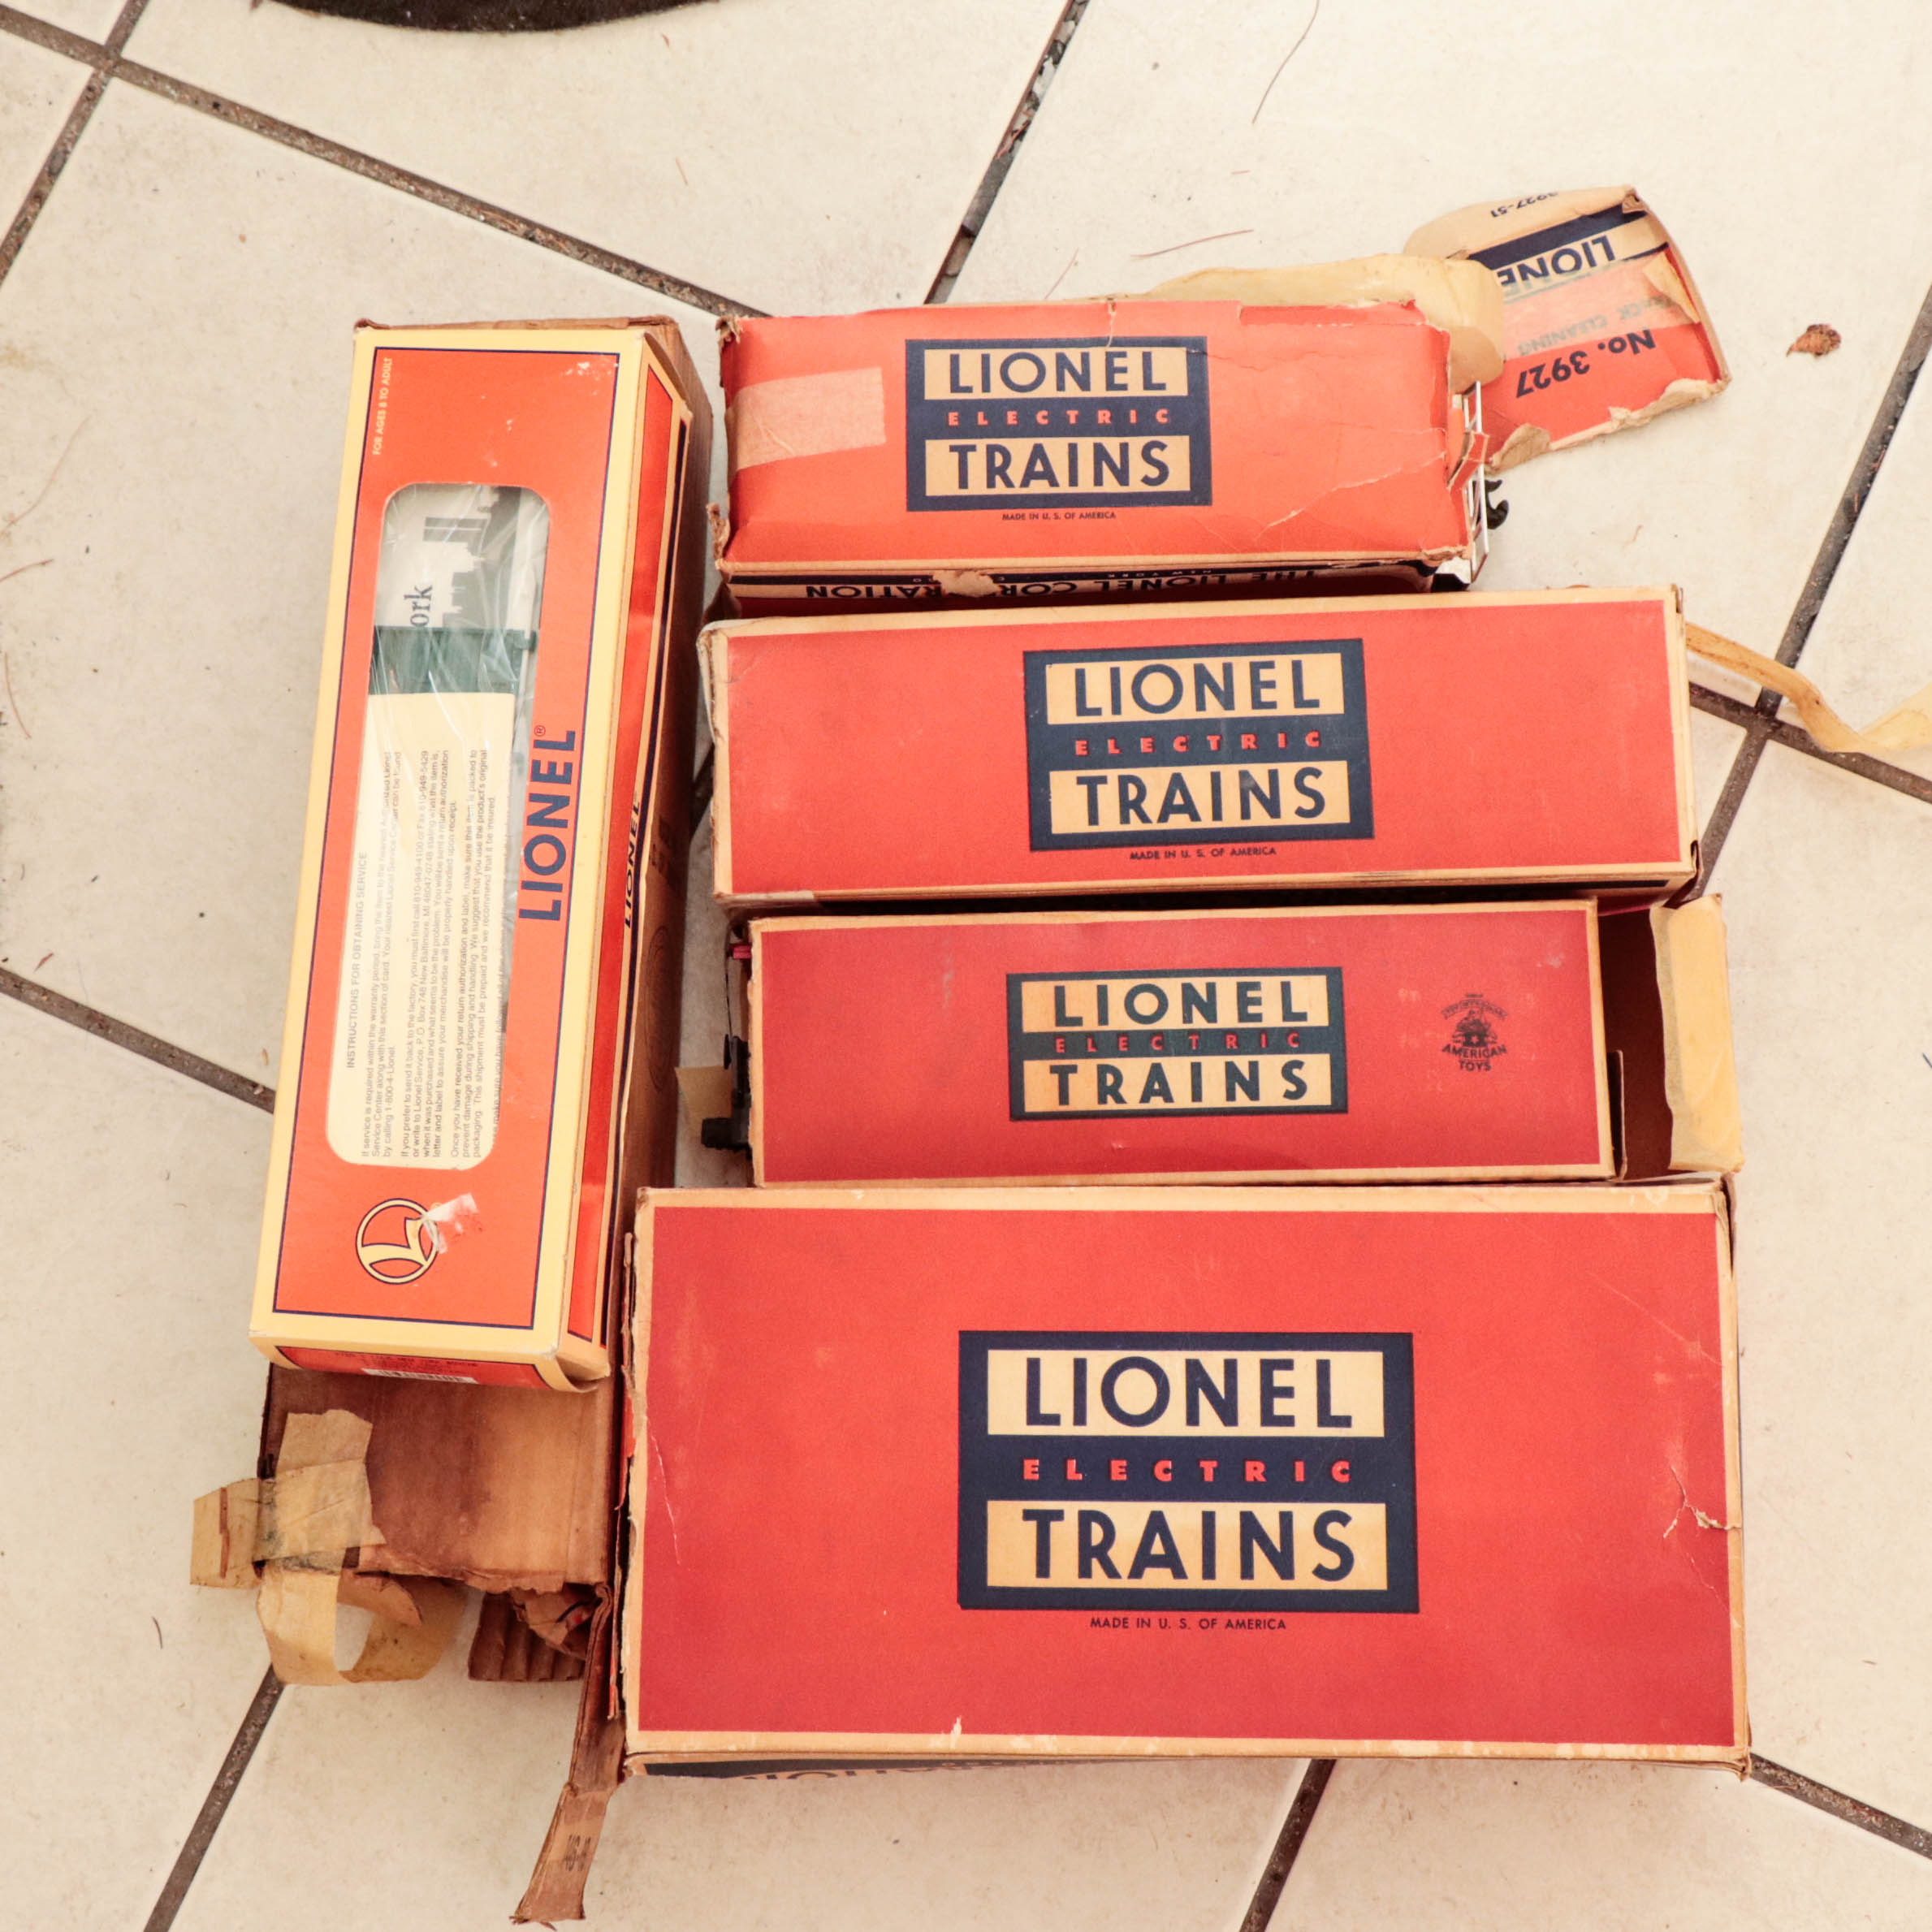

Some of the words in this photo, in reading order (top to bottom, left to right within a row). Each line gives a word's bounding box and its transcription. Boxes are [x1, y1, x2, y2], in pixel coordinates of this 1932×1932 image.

[1497, 235, 1616, 285] LIONE
[1517, 314, 1609, 356] CLEANING
[1597, 328, 1656, 356] No.
[381, 357, 392, 386] ADULT
[949, 351, 1167, 394] LIONEL
[1515, 350, 1590, 399] 3927
[379, 387, 389, 400] TO
[376, 409, 387, 434] AGES
[947, 408, 1169, 427] ELECTRIC
[372, 437, 383, 455] FOR
[949, 439, 1169, 490] TRAINS
[1002, 512, 1027, 521] MADE
[1028, 512, 1039, 521] IN
[1042, 512, 1052, 521] U.
[1053, 512, 1062, 521] S.
[1064, 512, 1076, 521] OF
[1078, 511, 1117, 520] AMERICA
[806, 581, 1077, 599] CORRATION
[1096, 574, 1226, 593] LIONEL
[403, 585, 434, 628] ork
[1074, 659, 1320, 717] LIONEL
[1074, 730, 1322, 756] ELECTRIC
[439, 750, 448, 805] authorization
[467, 760, 478, 791] packed
[479, 750, 489, 780] original
[1075, 767, 1326, 827] TRAINS
[625, 799, 640, 929] LIONEL
[1130, 851, 1160, 861] MADE
[1165, 850, 1177, 859] IN
[1181, 849, 1192, 858] U.
[1196, 849, 1206, 858] S.
[1211, 849, 1225, 858] OF
[1230, 847, 1277, 857] AMERICA
[356, 851, 366, 897] SERVICE
[462, 865, 471, 888] make
[476, 859, 484, 876] you
[482, 872, 491, 927] recommend
[460, 918, 469, 934] and
[471, 897, 482, 931] suggest
[352, 901, 364, 959] OBTAINING
[430, 948, 439, 961] the
[441, 948, 449, 961] will
[457, 936, 468, 993] authorization
[480, 945, 488, 962] and
[350, 962, 360, 984] FOR
[411, 962, 419, 977] you
[478, 966, 489, 999] prepaid
[369, 983, 380, 1020] warranty
[438, 965, 448, 1021] merchandise
[1053, 980, 1308, 1027] LIONEL
[378, 993, 387, 1024] section
[406, 1014, 415, 1027] the
[456, 996, 465, 1022] return
[345, 988, 358, 1068] INSTRUCTIONS
[367, 1023, 376, 1037] the
[378, 1027, 386, 1042] this
[427, 1016, 435, 1038] what
[439, 1025, 447, 1044] your
[457, 1026, 465, 1045] your
[465, 1013, 477, 1050] shipping
[477, 1016, 485, 1038] must
[365, 1039, 374, 1065] within
[376, 1044, 385, 1061] with
[404, 1041, 413, 1061] back
[426, 1039, 434, 1056] and
[1054, 1032, 1300, 1054] ELECTRIC
[1441, 1044, 1507, 1058] AMERICAN
[453, 1048, 462, 1085] received
[464, 1053, 474, 1082] during
[474, 1041, 486, 1082] shipment
[1459, 1059, 1492, 1071] TOYS
[364, 1068, 375, 1104] required
[374, 1064, 386, 1088] along
[403, 1070, 412, 1092] send
[424, 1057, 435, 1104] purchased
[1049, 1059, 1308, 1106] TRAINS
[373, 1090, 382, 1121] Center
[413, 1084, 421, 1111] Lionel
[434, 1091, 443, 1112] label
[452, 1088, 460, 1110] have
[462, 1084, 473, 1121] damage
[473, 1085, 482, 1103] This
[383, 1114, 394, 1143] calling
[401, 1104, 413, 1130] prefer
[433, 1114, 441, 1131] and
[453, 1113, 461, 1130] you
[361, 1117, 370, 1148] service
[371, 1123, 380, 1156] Service
[402, 1133, 411, 1149] you
[411, 1124, 420, 1145] write
[421, 1132, 430, 1157] when
[431, 1135, 440, 1156] letter
[450, 1132, 459, 1156] Once
[460, 1123, 471, 1156] prevent
[1026, 1356, 1353, 1428] LIONEL
[1022, 1458, 1353, 1483] ELECTRIC
[1022, 1508, 1355, 1582] TRAINS
[1091, 1618, 1129, 1628] MADE
[1136, 1618, 1152, 1628] IN
[1158, 1618, 1172, 1629] U.
[1178, 1619, 1191, 1629] S.
[1199, 1619, 1218, 1630] OF
[1225, 1619, 1286, 1630] AMERICA
